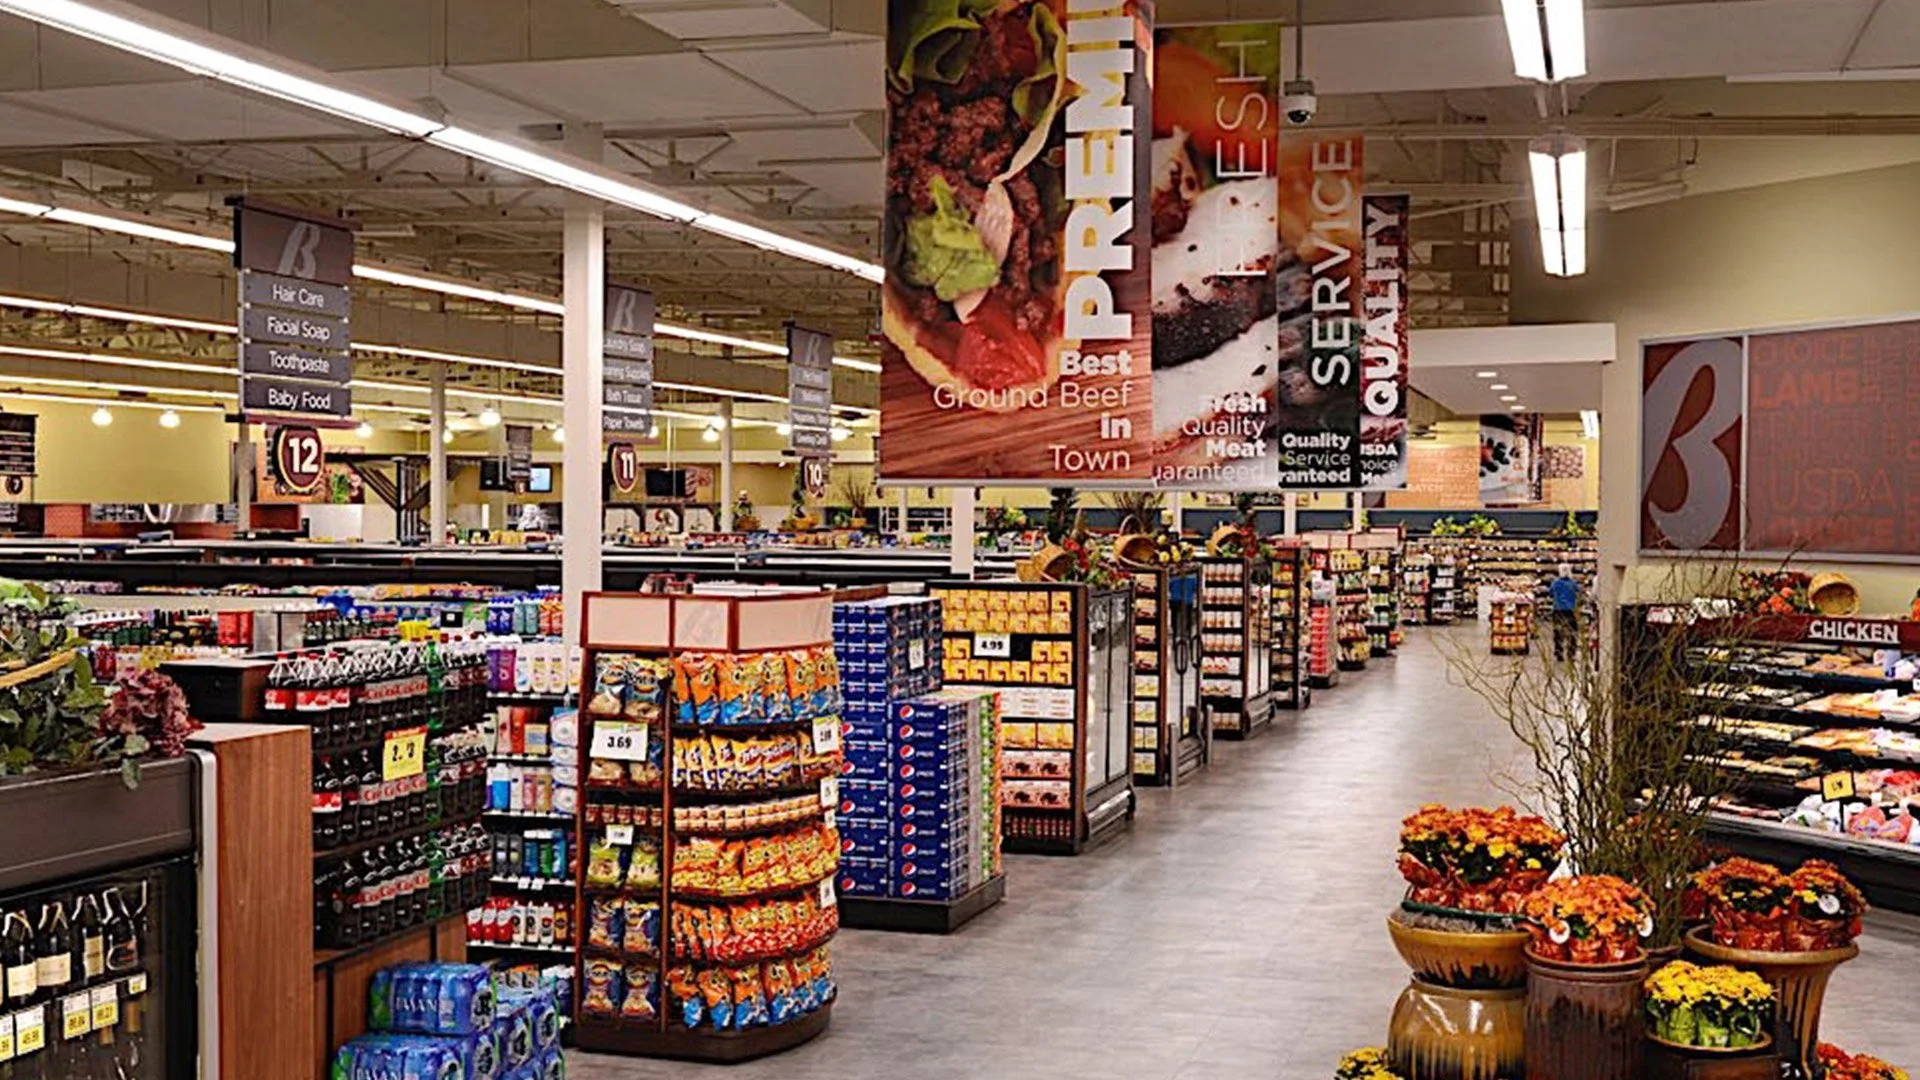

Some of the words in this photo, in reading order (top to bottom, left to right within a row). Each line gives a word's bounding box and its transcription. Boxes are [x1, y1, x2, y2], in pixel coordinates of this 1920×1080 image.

[1065, 0, 1135, 340] PREMI
[1216, 39, 1267, 276] FRESH
[1312, 140, 1352, 386] SERVICE
[273, 284, 297, 302] Hair
[298, 288, 324, 308] Care
[1363, 203, 1400, 417] QUALITY
[267, 316, 300, 337] Facial
[301, 321, 331, 342] Soap
[269, 350, 331, 374] Toothpaste
[1060, 349, 1133, 375] Best
[268, 388, 299, 410] Baby
[302, 391, 331, 410] Food
[934, 381, 1048, 409] Ground
[1061, 381, 1133, 408] Beef
[1752, 367, 1859, 408] LAMB
[1100, 412, 1132, 439] in
[1183, 416, 1266, 438] Quality
[1206, 440, 1267, 458] Meat
[1282, 433, 1351, 451] Quality
[288, 437, 320, 474] 12
[621, 452, 634, 479] 11
[1049, 445, 1131, 471] Town
[1285, 450, 1351, 466] Service
[808, 464, 822, 486] 10
[1153, 463, 1266, 482] uaranteed
[1278, 468, 1351, 484] ranteed
[1770, 466, 1897, 513] USDA
[1808, 620, 1900, 643] CHICKEN
[981, 640, 1004, 651] 4.99
